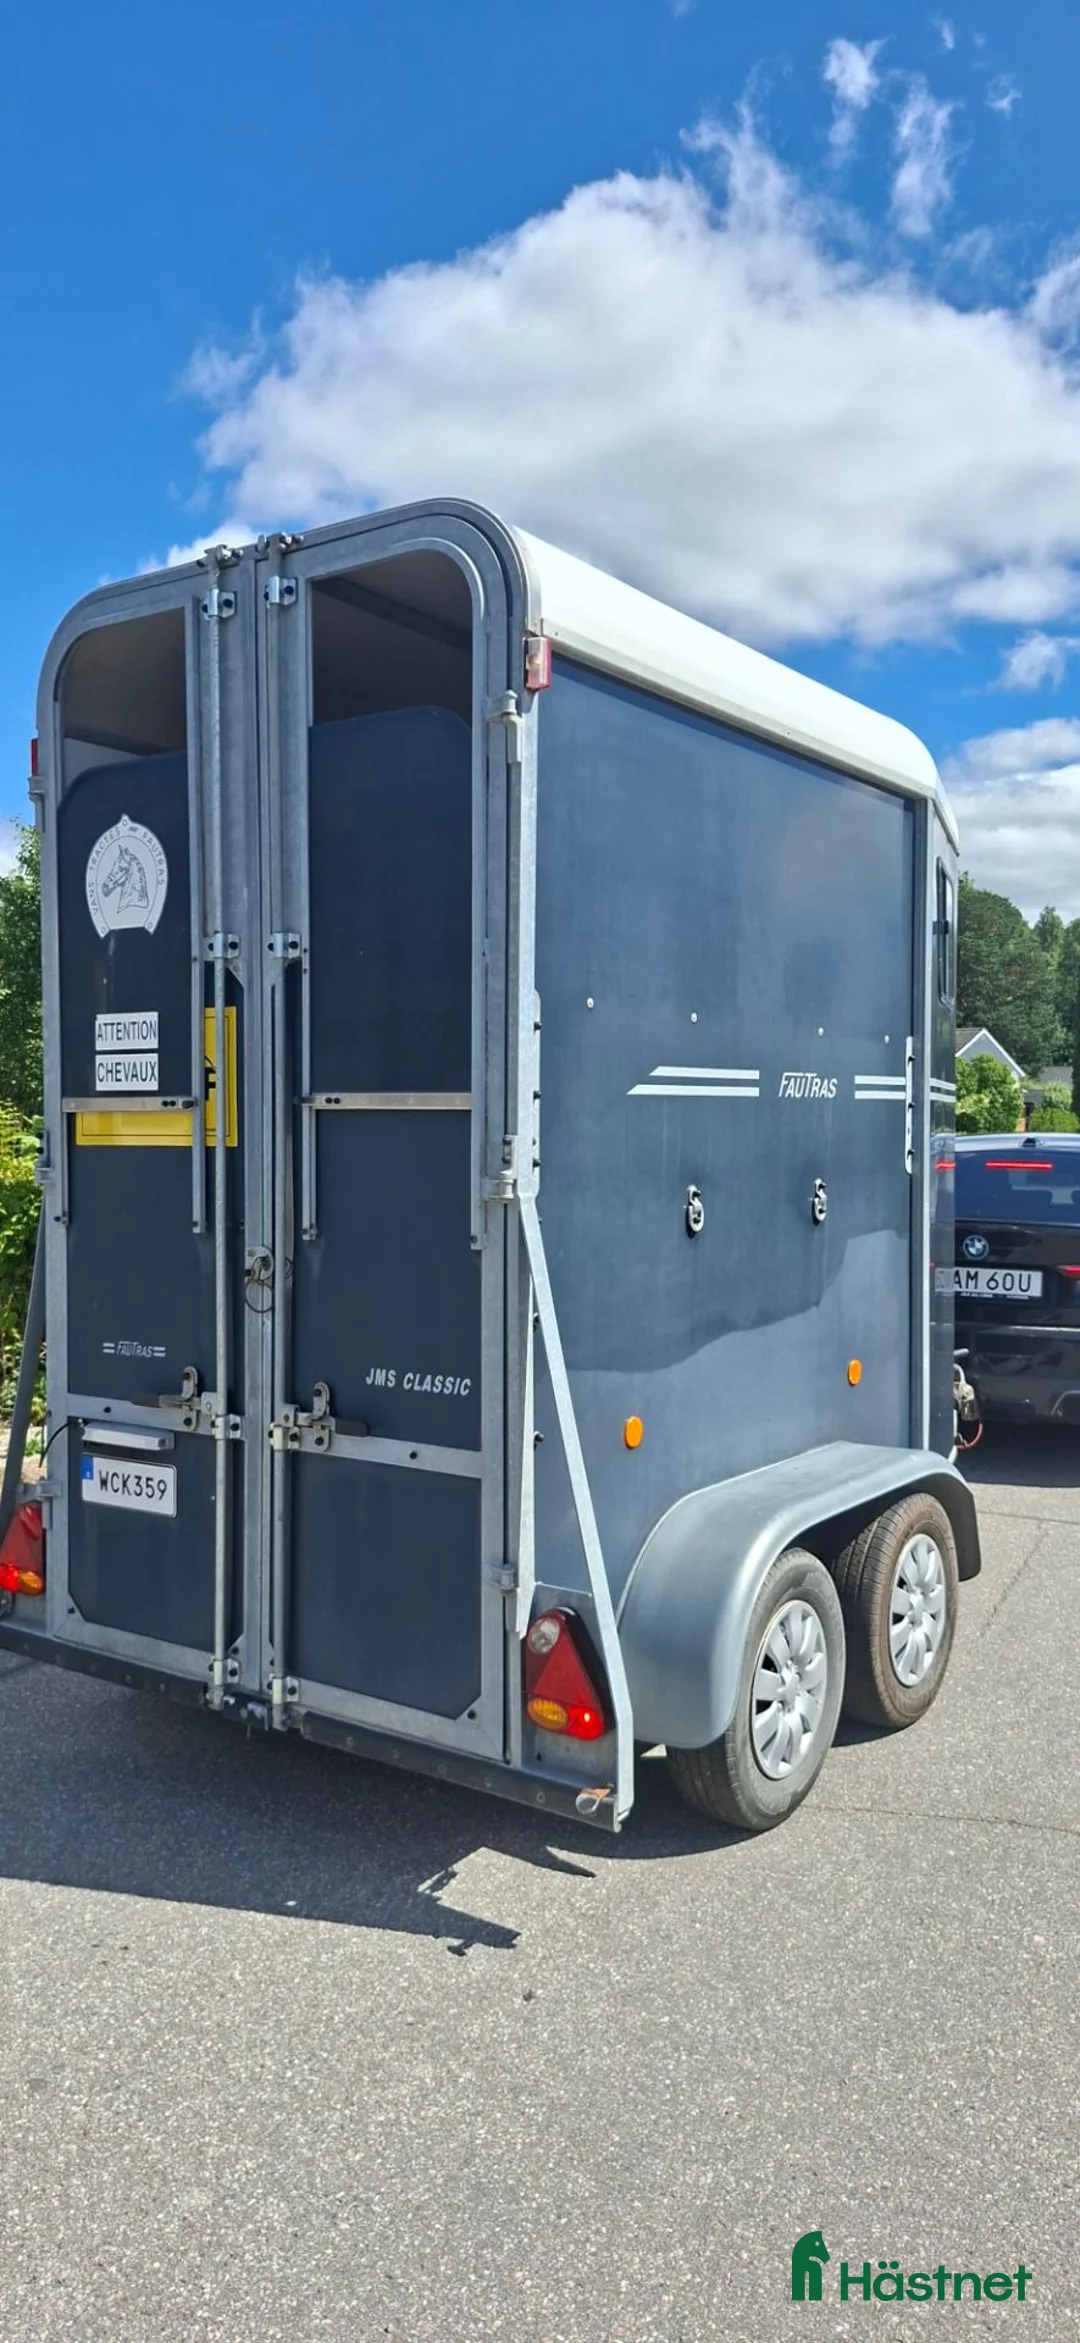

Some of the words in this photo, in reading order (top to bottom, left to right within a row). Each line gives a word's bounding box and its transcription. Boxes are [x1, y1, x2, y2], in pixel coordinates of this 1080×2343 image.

[97, 1020, 157, 1041] ATTENTION
[97, 1061, 157, 1083] CHEVAUX
[778, 1072, 838, 1099] FAUTRAS
[986, 1271, 1031, 1293] 60U
[365, 1367, 397, 1388] JMS
[402, 1372, 471, 1396] CLASSIC
[98, 1469, 167, 1501] WCK359
